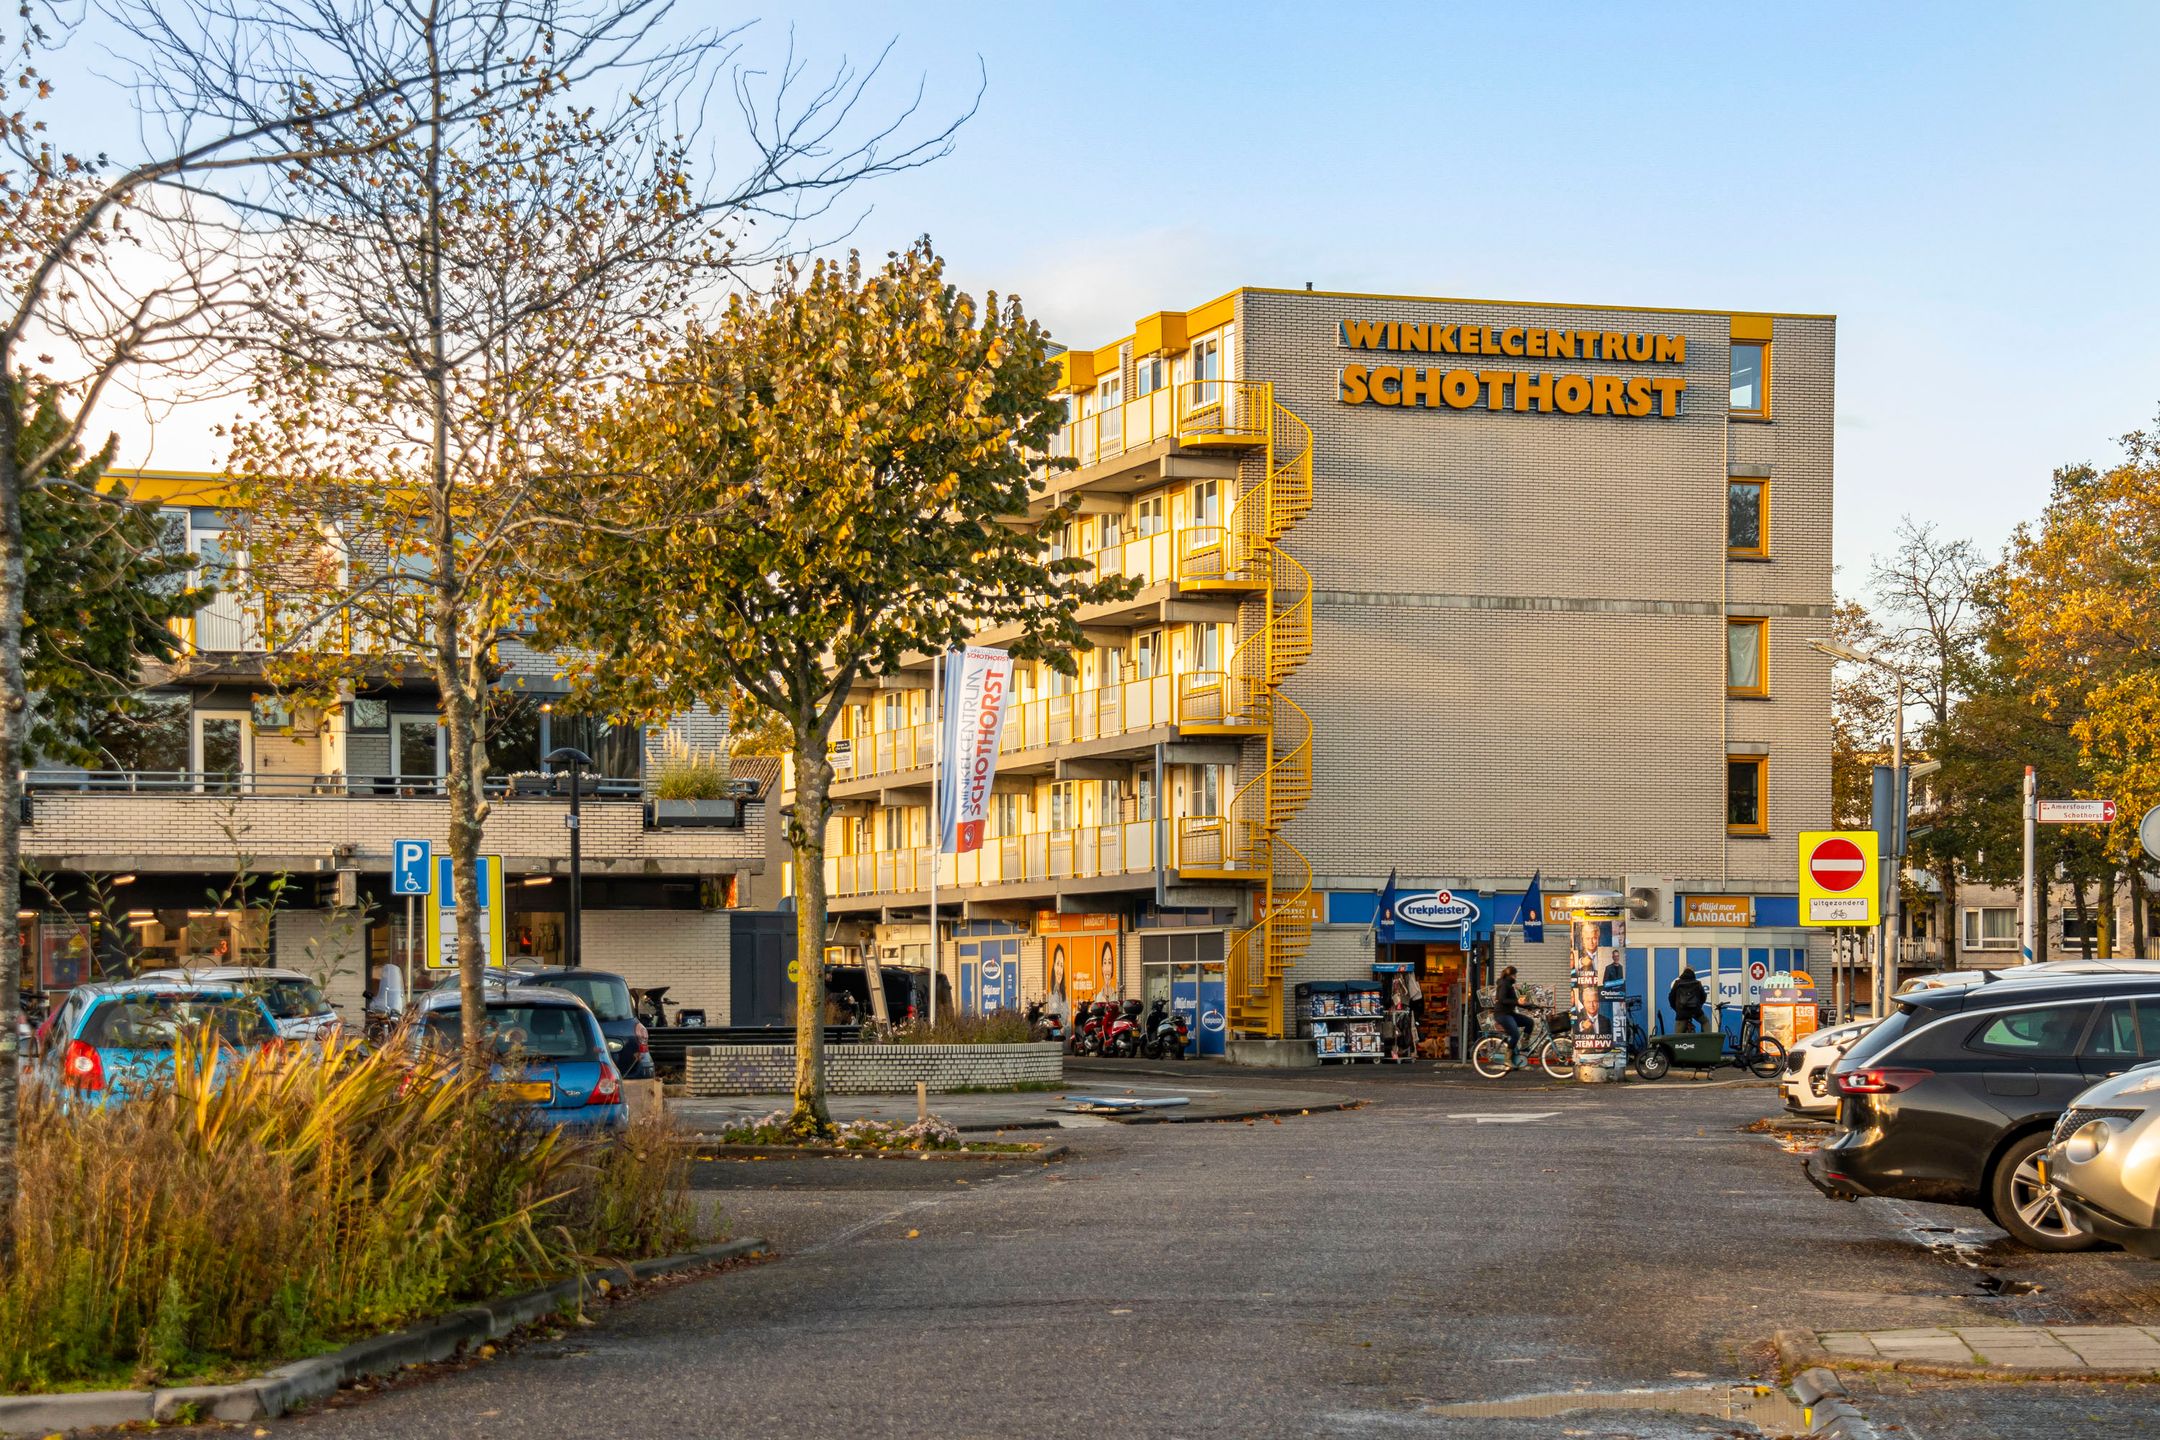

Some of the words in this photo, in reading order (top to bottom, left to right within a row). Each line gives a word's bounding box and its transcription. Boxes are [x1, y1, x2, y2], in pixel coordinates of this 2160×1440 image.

[1342, 320, 1686, 363] WINKELCENTRUM
[1340, 363, 1687, 417] SCHOTHORST
[969, 668, 1004, 816] SCHOTHORST
[402, 844, 423, 872] P
[1407, 904, 1467, 917] trekpleister
[1687, 912, 1747, 923] AANDACHT
[1575, 1040, 1594, 1049] STEM
[1594, 1040, 1612, 1048] PVV
